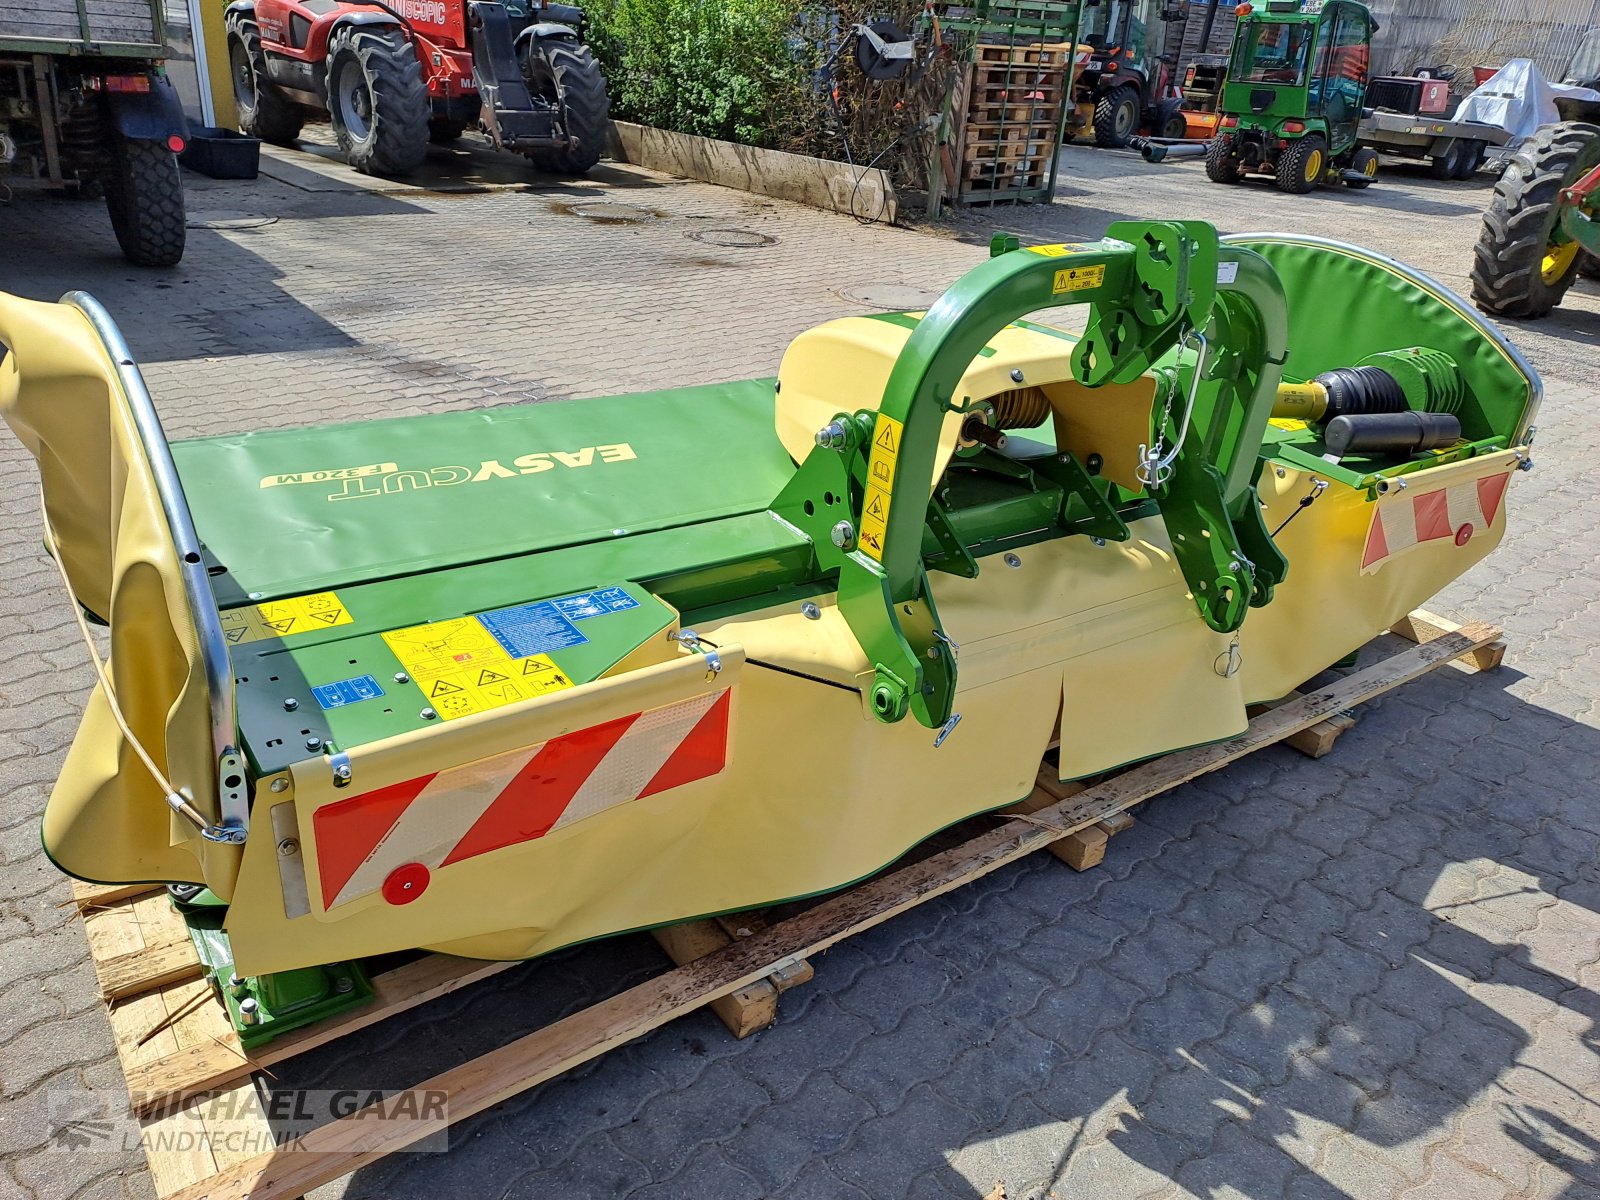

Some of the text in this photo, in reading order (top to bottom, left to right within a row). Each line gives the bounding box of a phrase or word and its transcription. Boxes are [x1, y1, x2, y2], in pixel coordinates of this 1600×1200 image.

[461, 78, 478, 88] MA
[277, 464, 383, 484] F 320 M
[327, 442, 638, 501] EASYCUT
[450, 706, 474, 716] STOP
